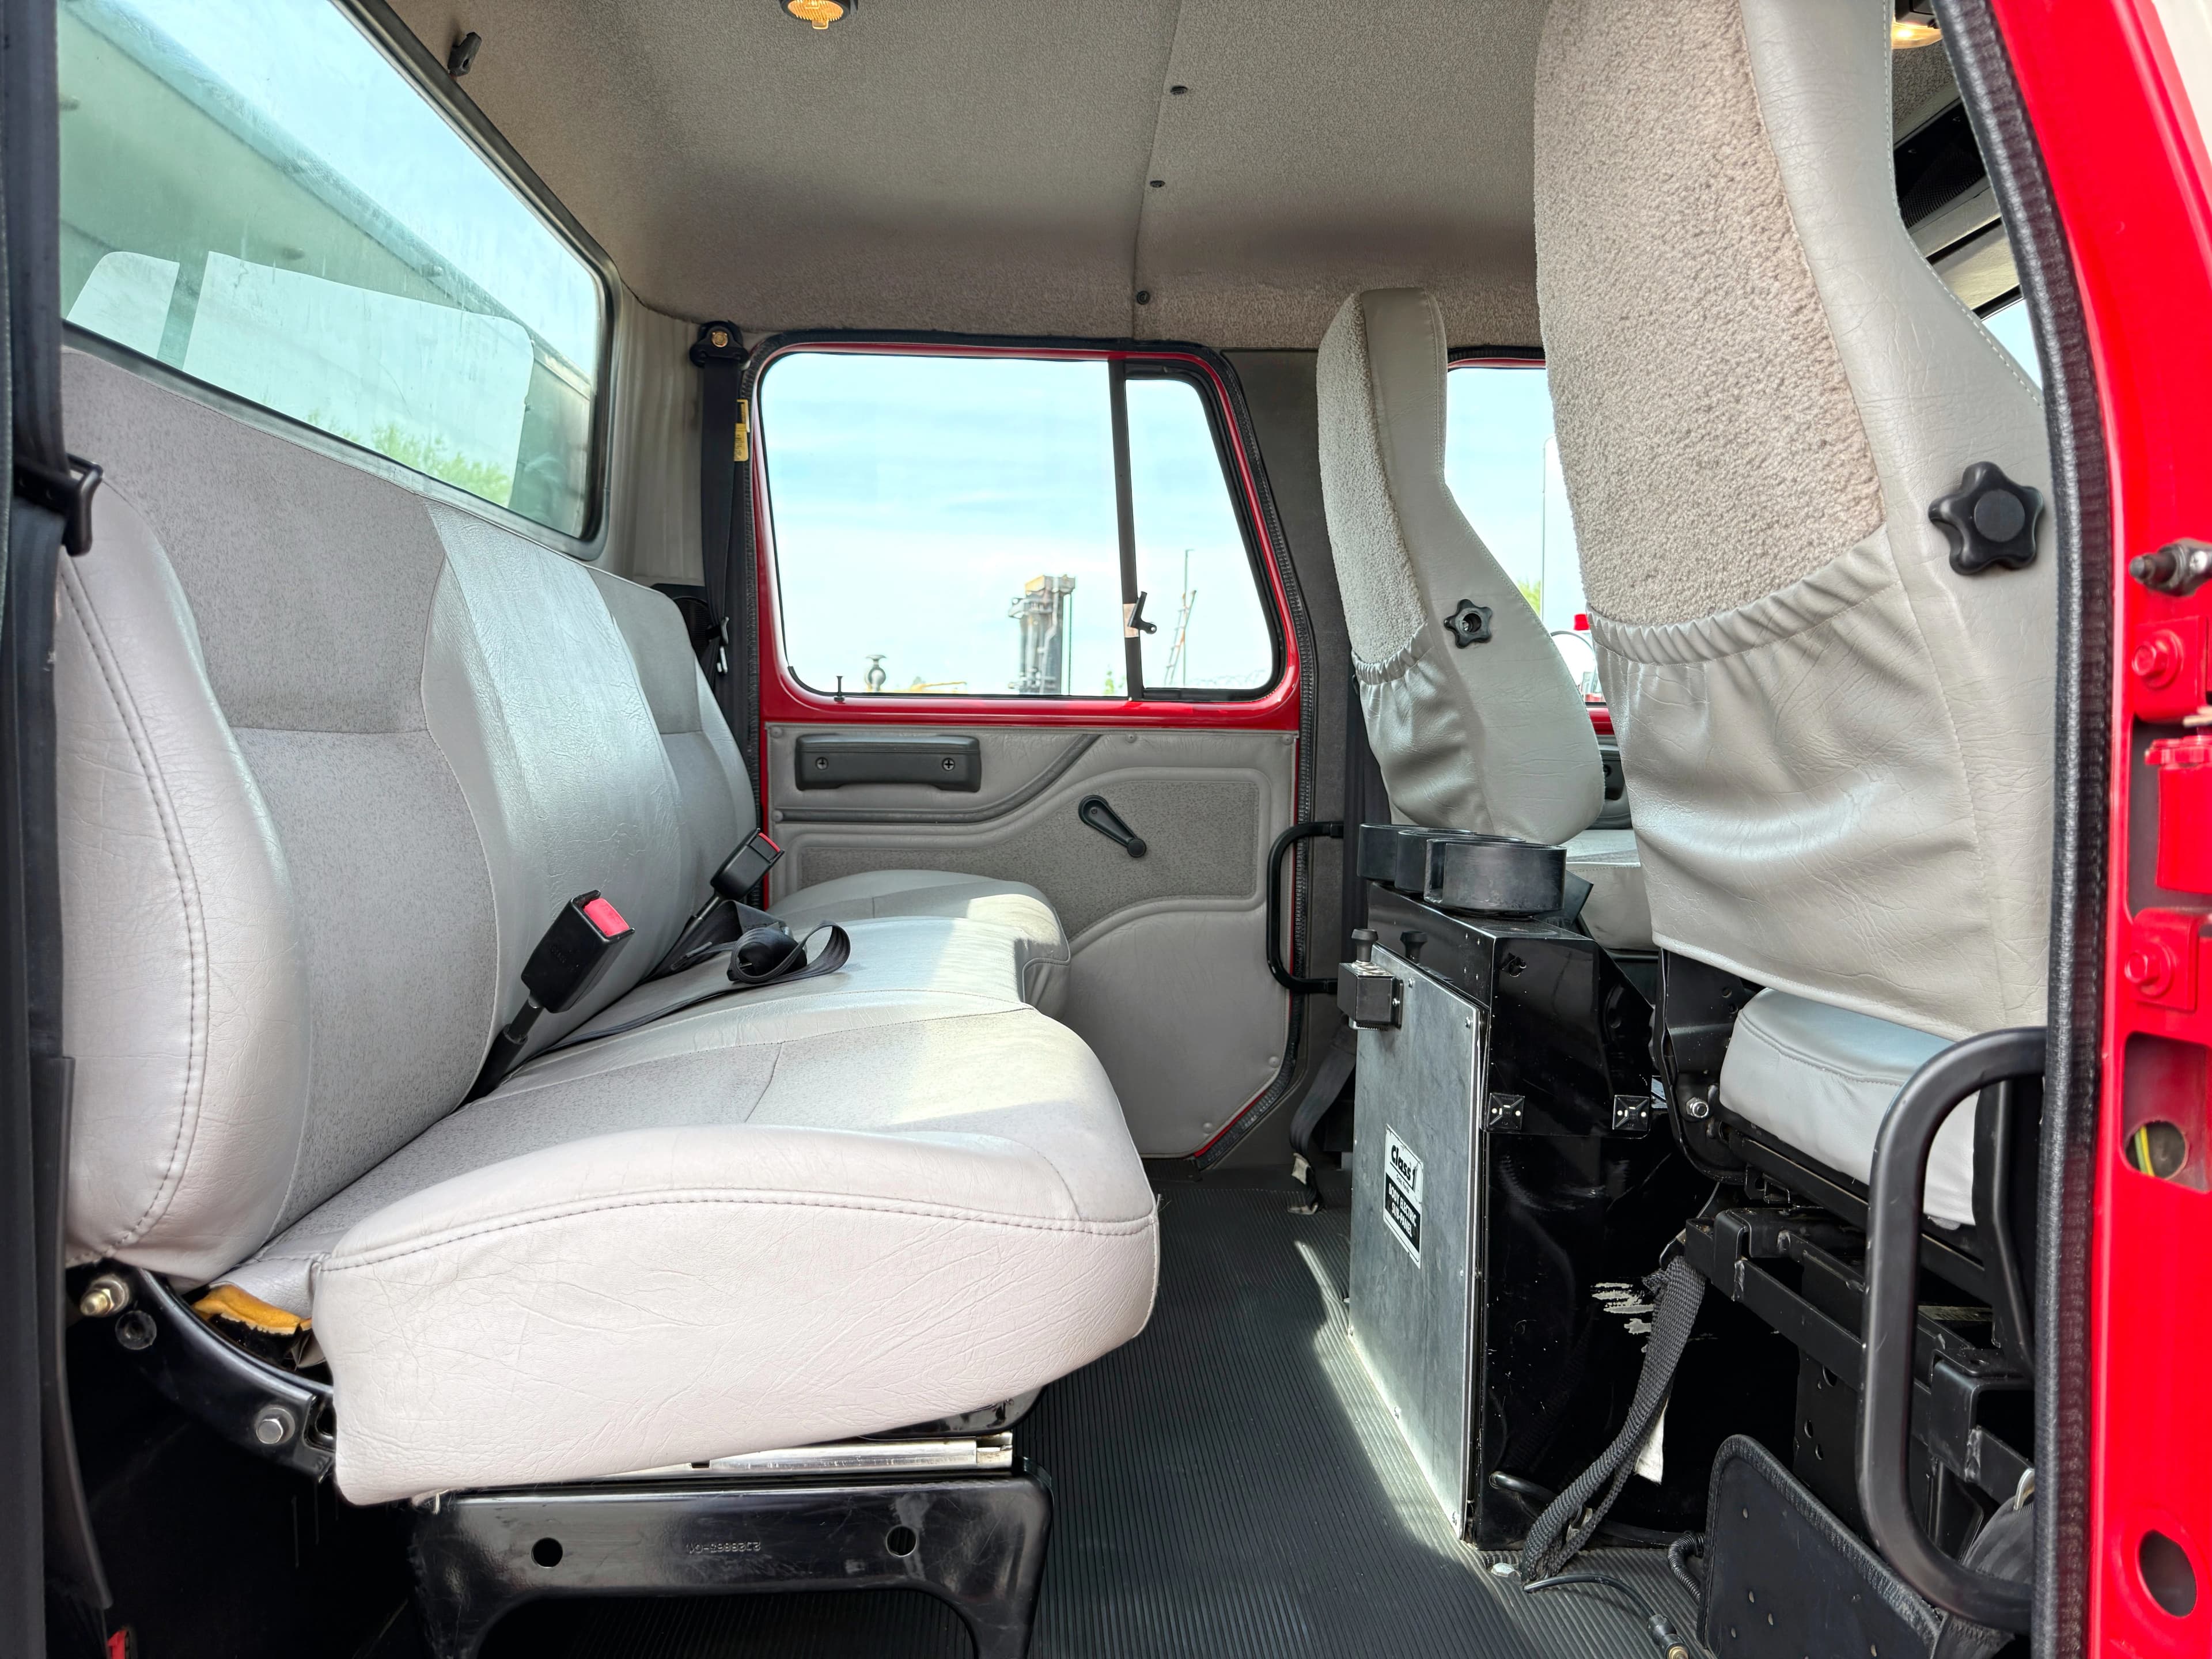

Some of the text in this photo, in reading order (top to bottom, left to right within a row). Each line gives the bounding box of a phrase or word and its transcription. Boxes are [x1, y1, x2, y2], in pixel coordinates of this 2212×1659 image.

[1391, 1145, 1411, 1181] Class
[1412, 1168, 1417, 1191] 1
[1388, 1183, 1400, 1205] BODY
[1400, 1197, 1416, 1227] ELECTRIC
[1392, 1202, 1412, 1237] SUB-PANEL
